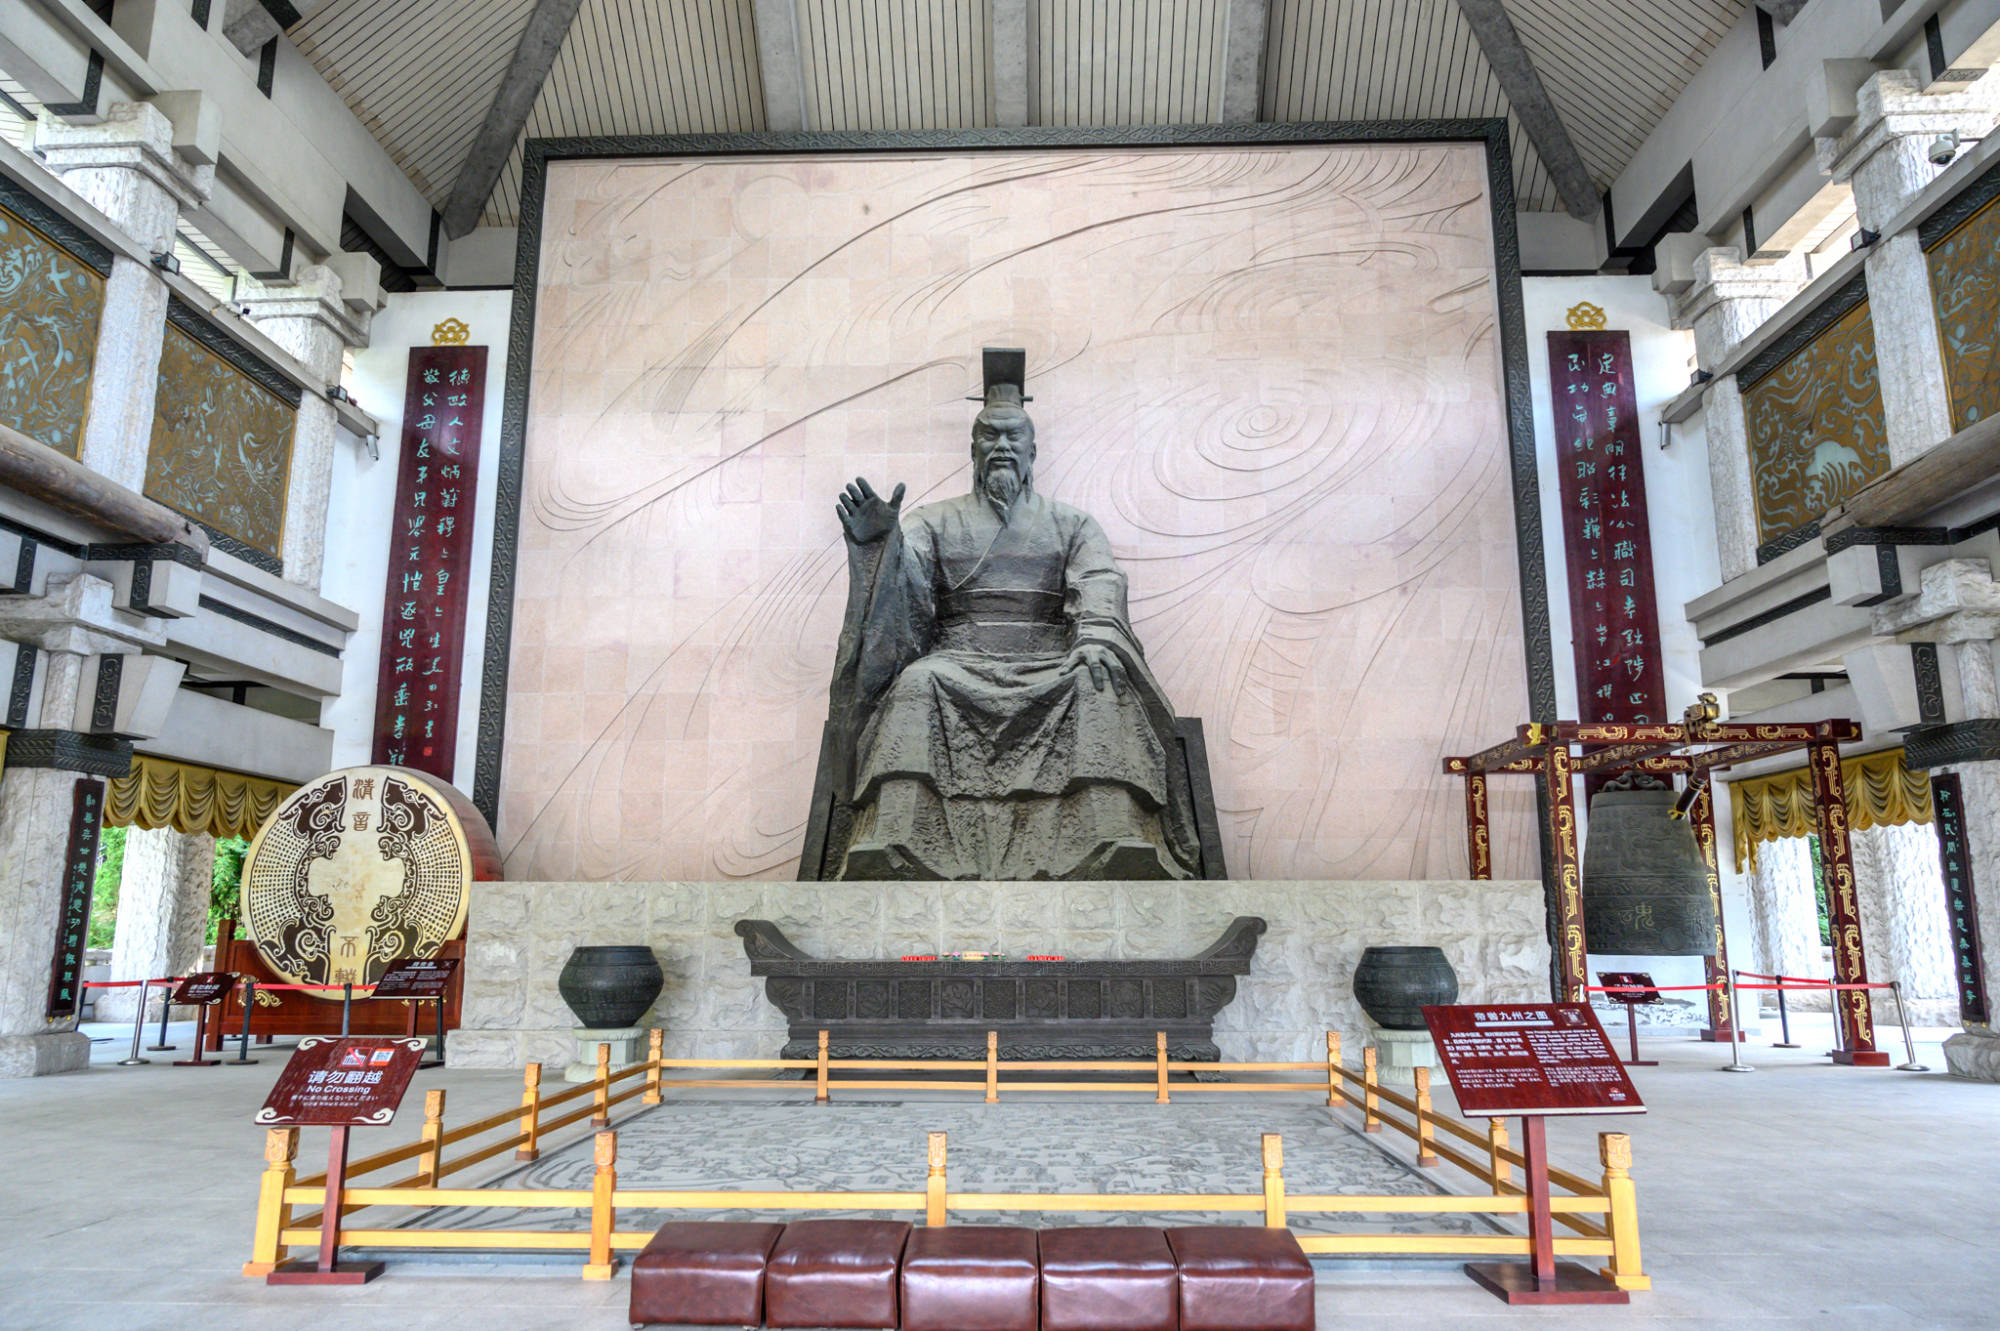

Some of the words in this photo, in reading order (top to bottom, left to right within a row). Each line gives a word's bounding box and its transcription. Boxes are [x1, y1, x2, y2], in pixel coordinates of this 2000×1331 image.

[307, 1070, 384, 1084] 请勿翻越
[306, 1085, 322, 1093] No
[324, 1085, 372, 1095] Crossing
